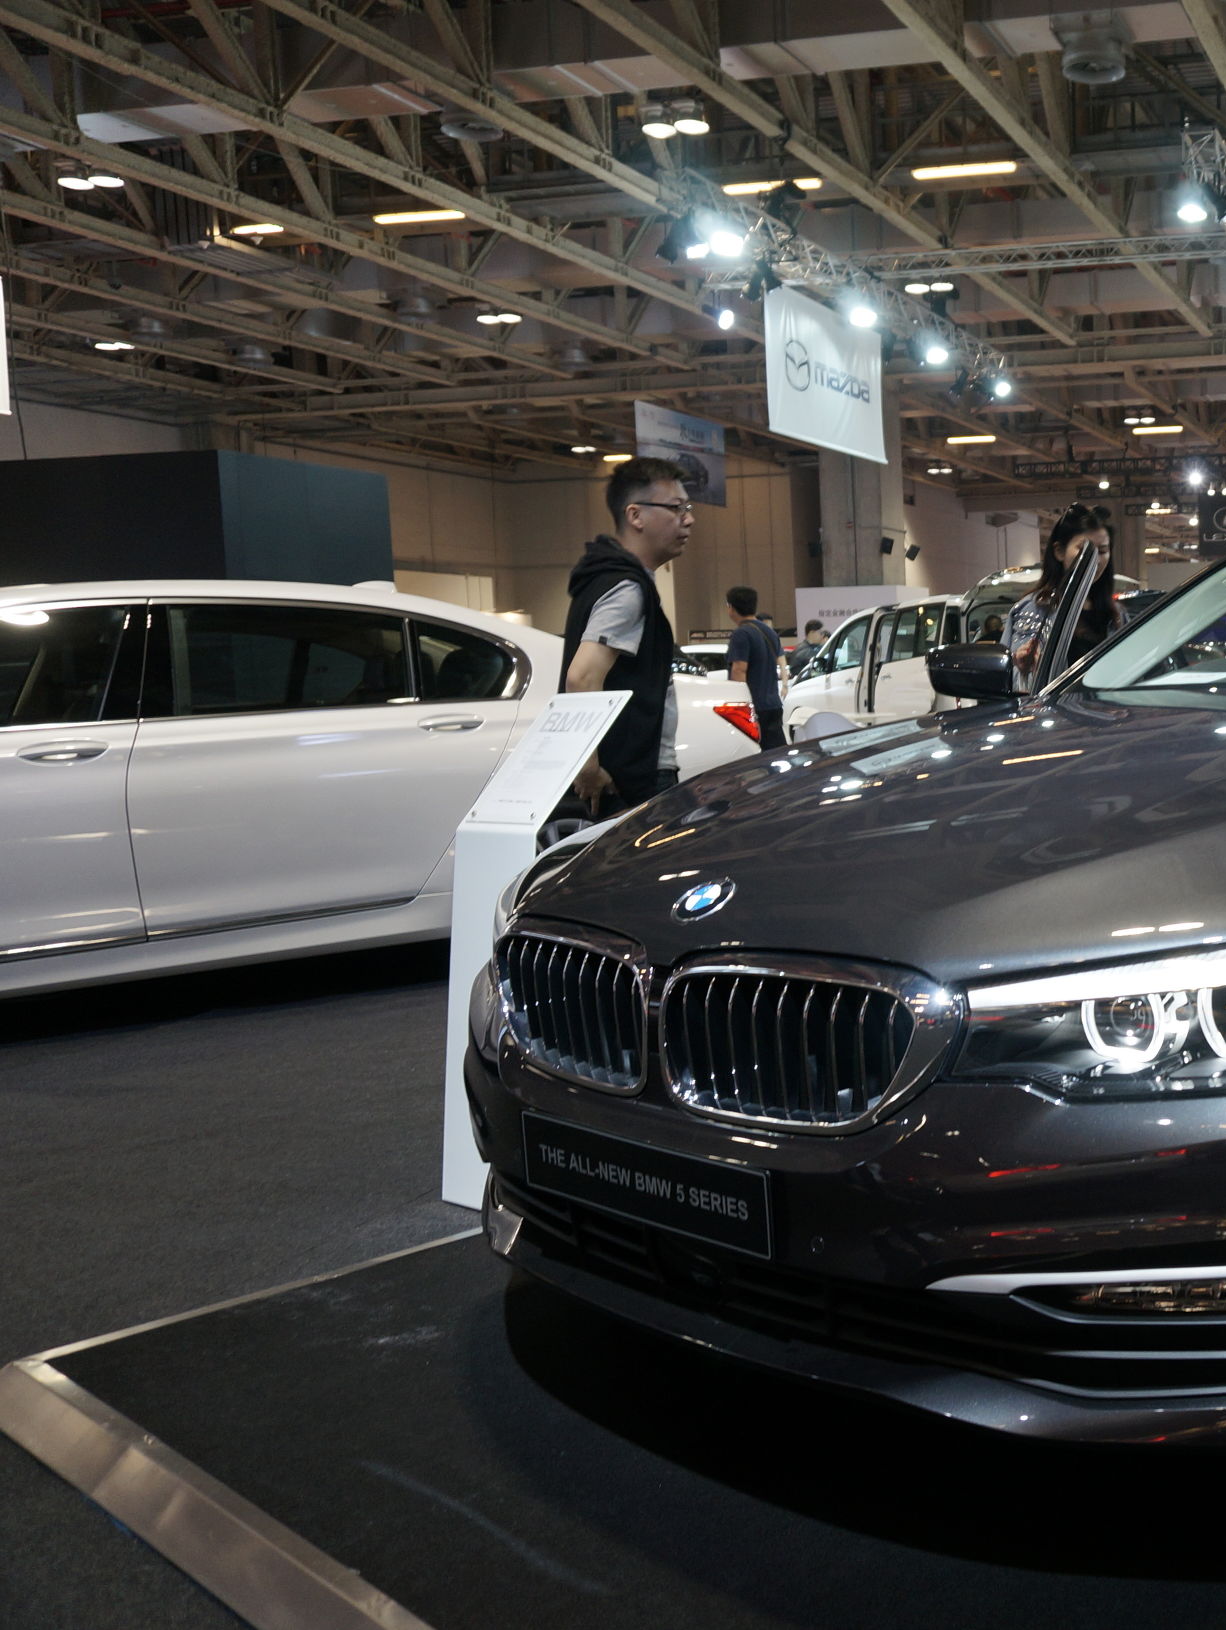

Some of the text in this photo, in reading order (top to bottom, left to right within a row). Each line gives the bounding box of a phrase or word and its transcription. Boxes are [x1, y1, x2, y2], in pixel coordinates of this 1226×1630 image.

[540, 711, 605, 733] BMW
[539, 1144, 749, 1221] THE ALL-NEW BMW 5 SERIES
